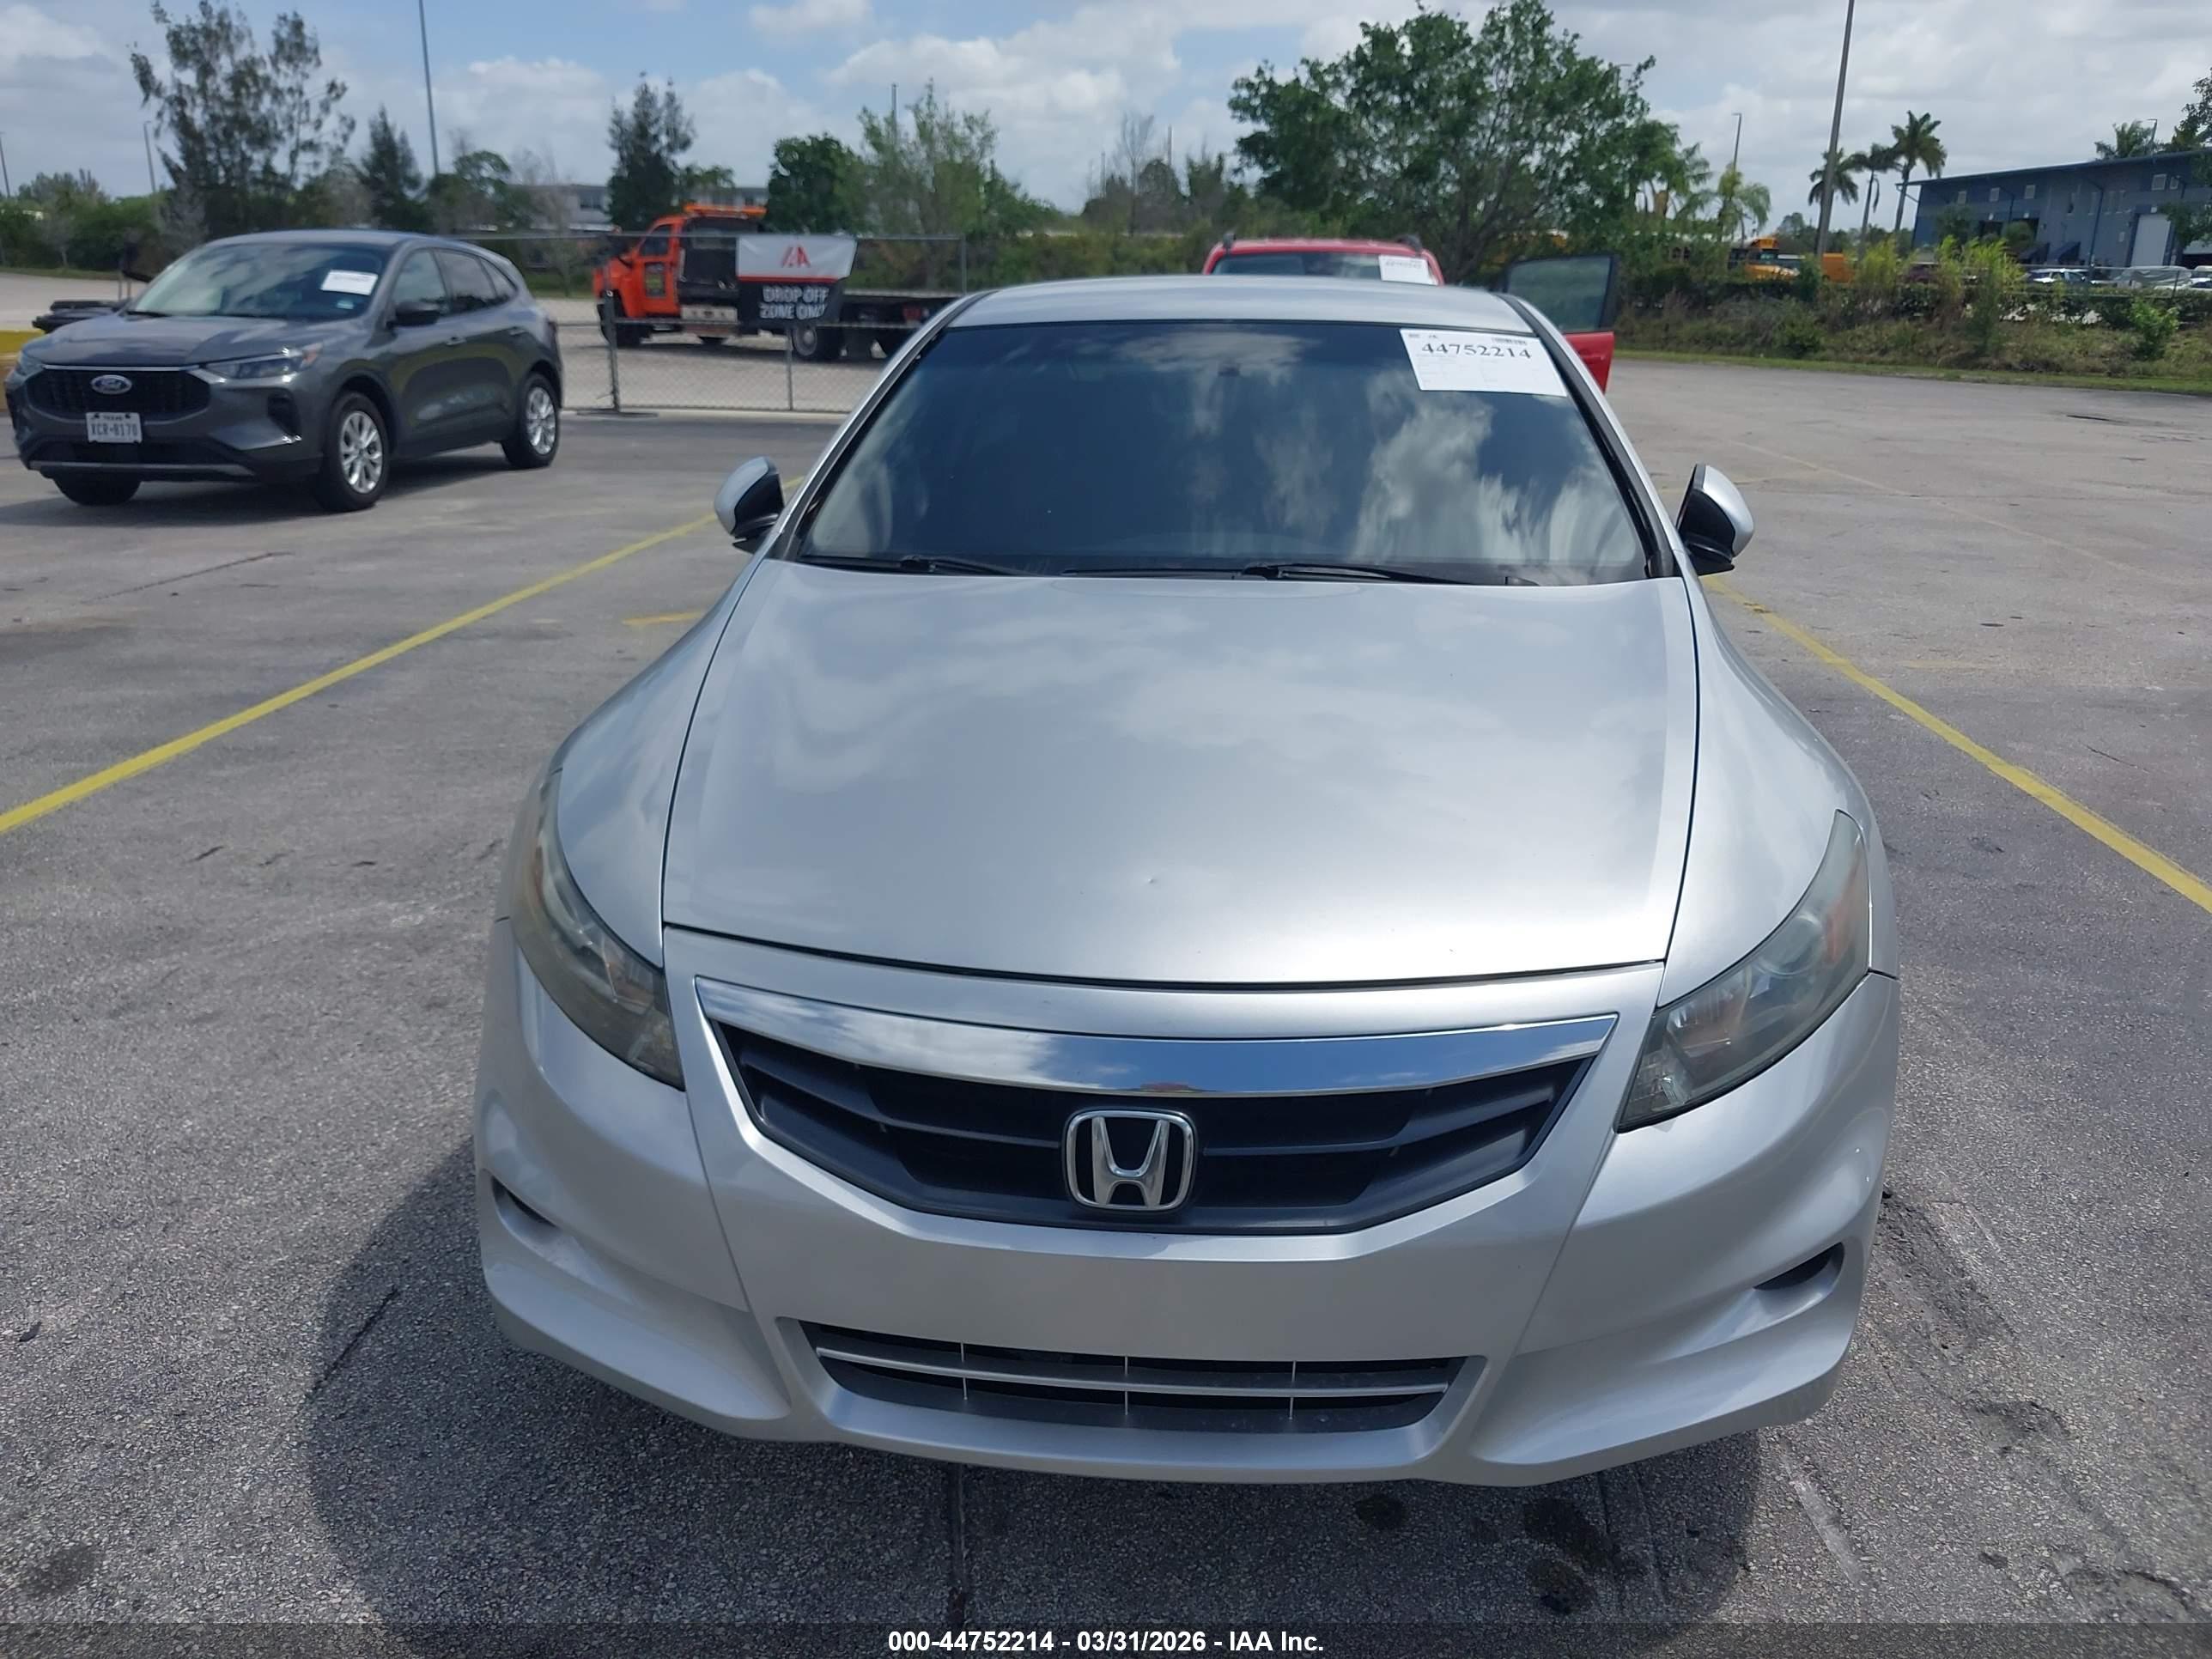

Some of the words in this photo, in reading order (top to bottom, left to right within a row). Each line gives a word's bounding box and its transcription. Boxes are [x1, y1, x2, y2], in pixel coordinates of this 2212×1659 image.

[763, 286, 802, 302] DROP
[803, 287, 830, 303] OFF
[759, 303, 795, 319] ZONE
[1421, 343, 1532, 359] 44752214
